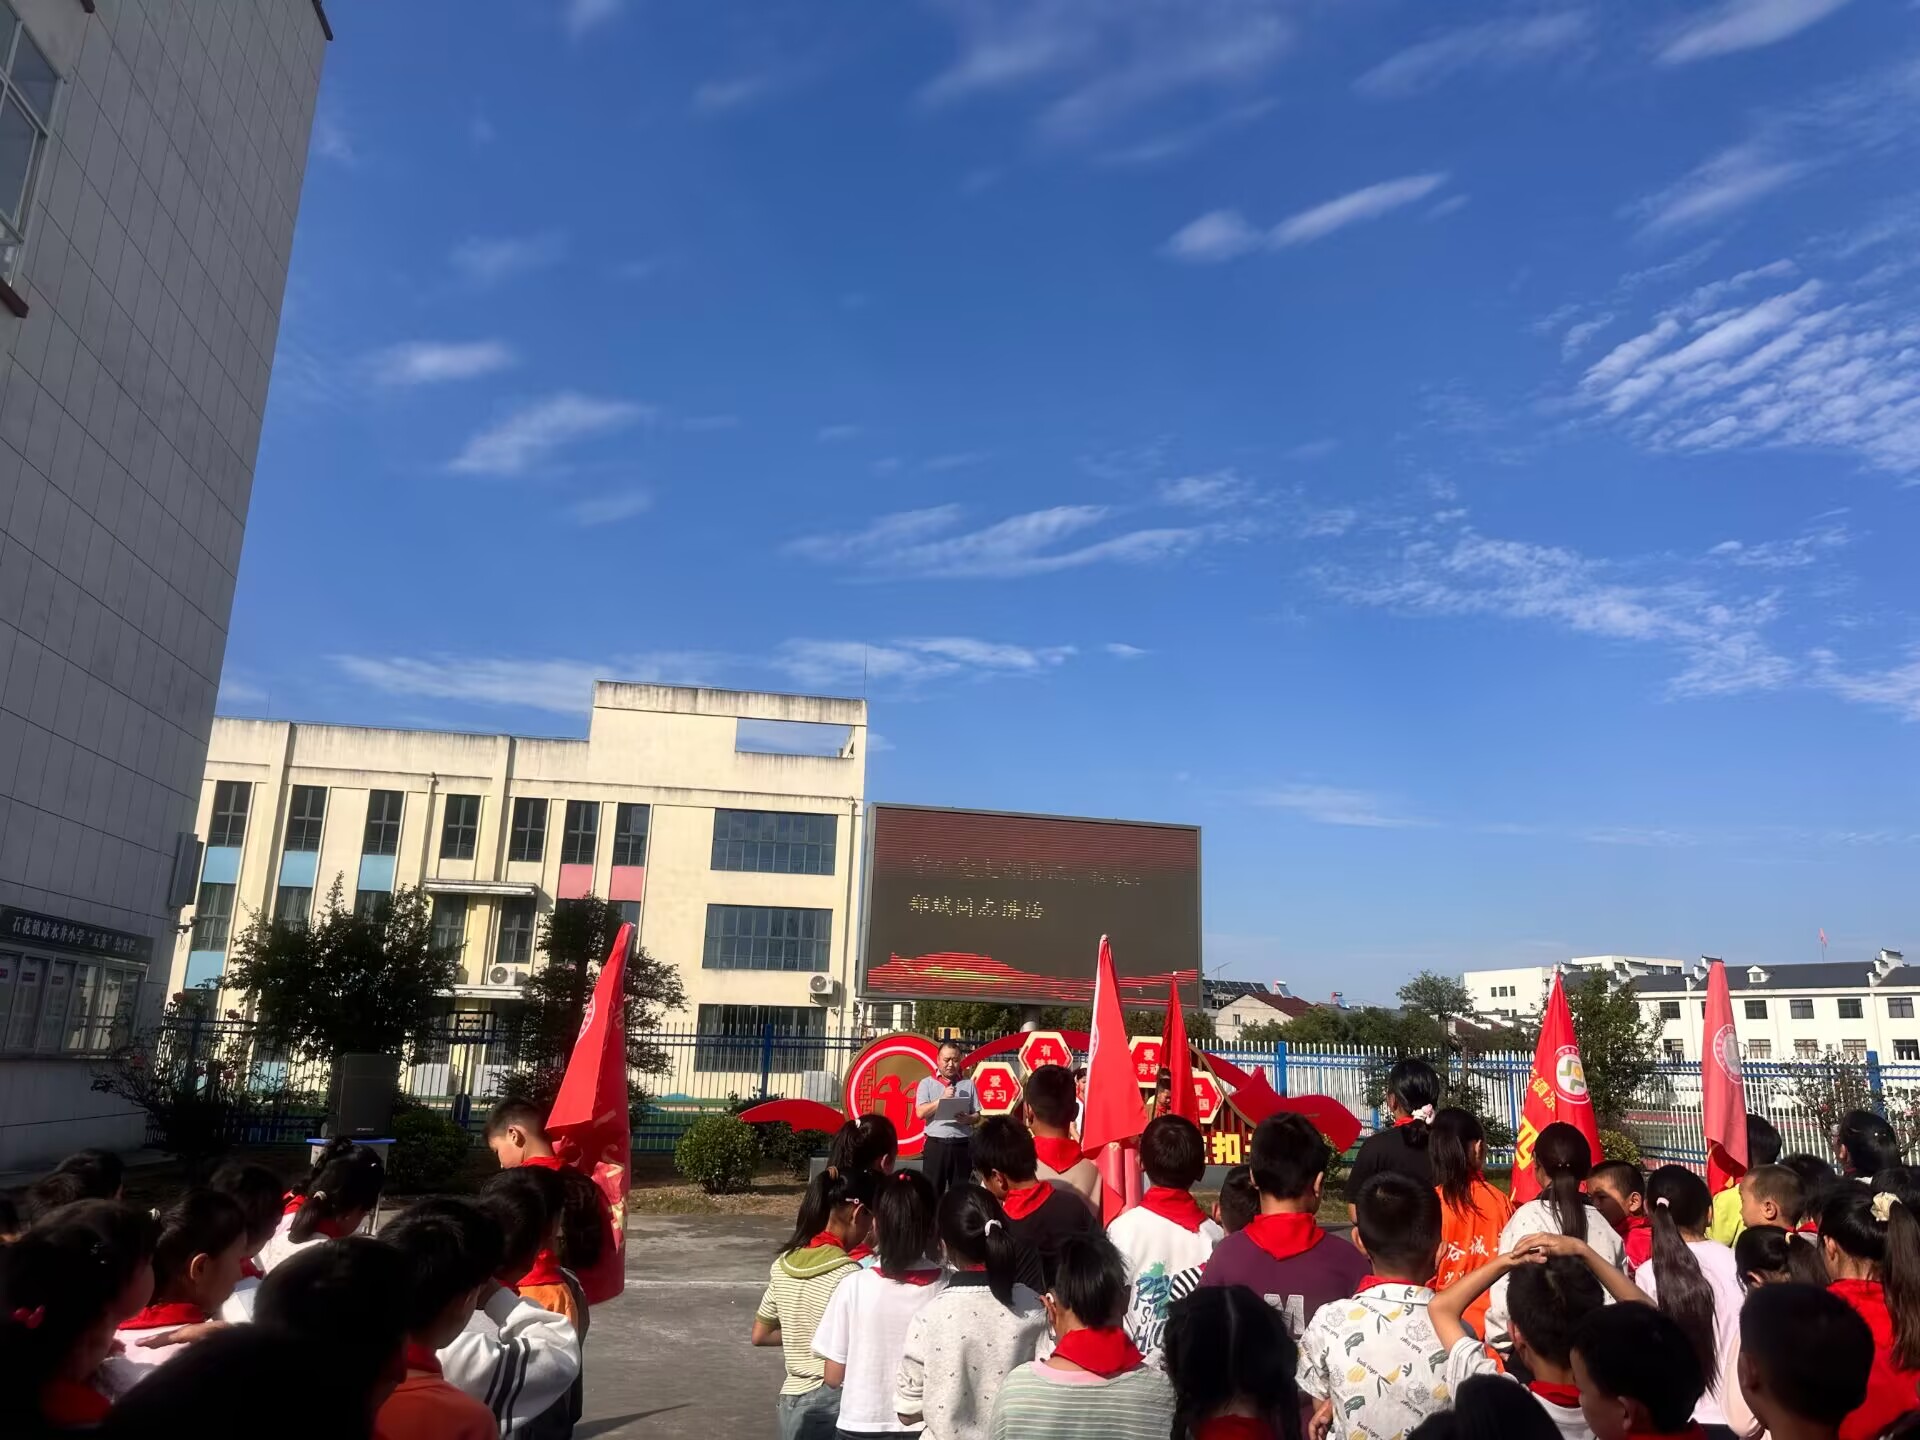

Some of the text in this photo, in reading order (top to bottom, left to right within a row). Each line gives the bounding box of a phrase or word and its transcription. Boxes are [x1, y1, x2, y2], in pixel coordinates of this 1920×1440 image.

[1040, 1044, 1052, 1057] 有
[1143, 1048, 1155, 1061] 爱
[989, 1074, 1002, 1087] 爱
[983, 1090, 1007, 1103] 学习
[1198, 1098, 1210, 1111] 国
[1445, 1233, 1500, 1262] 谷城
